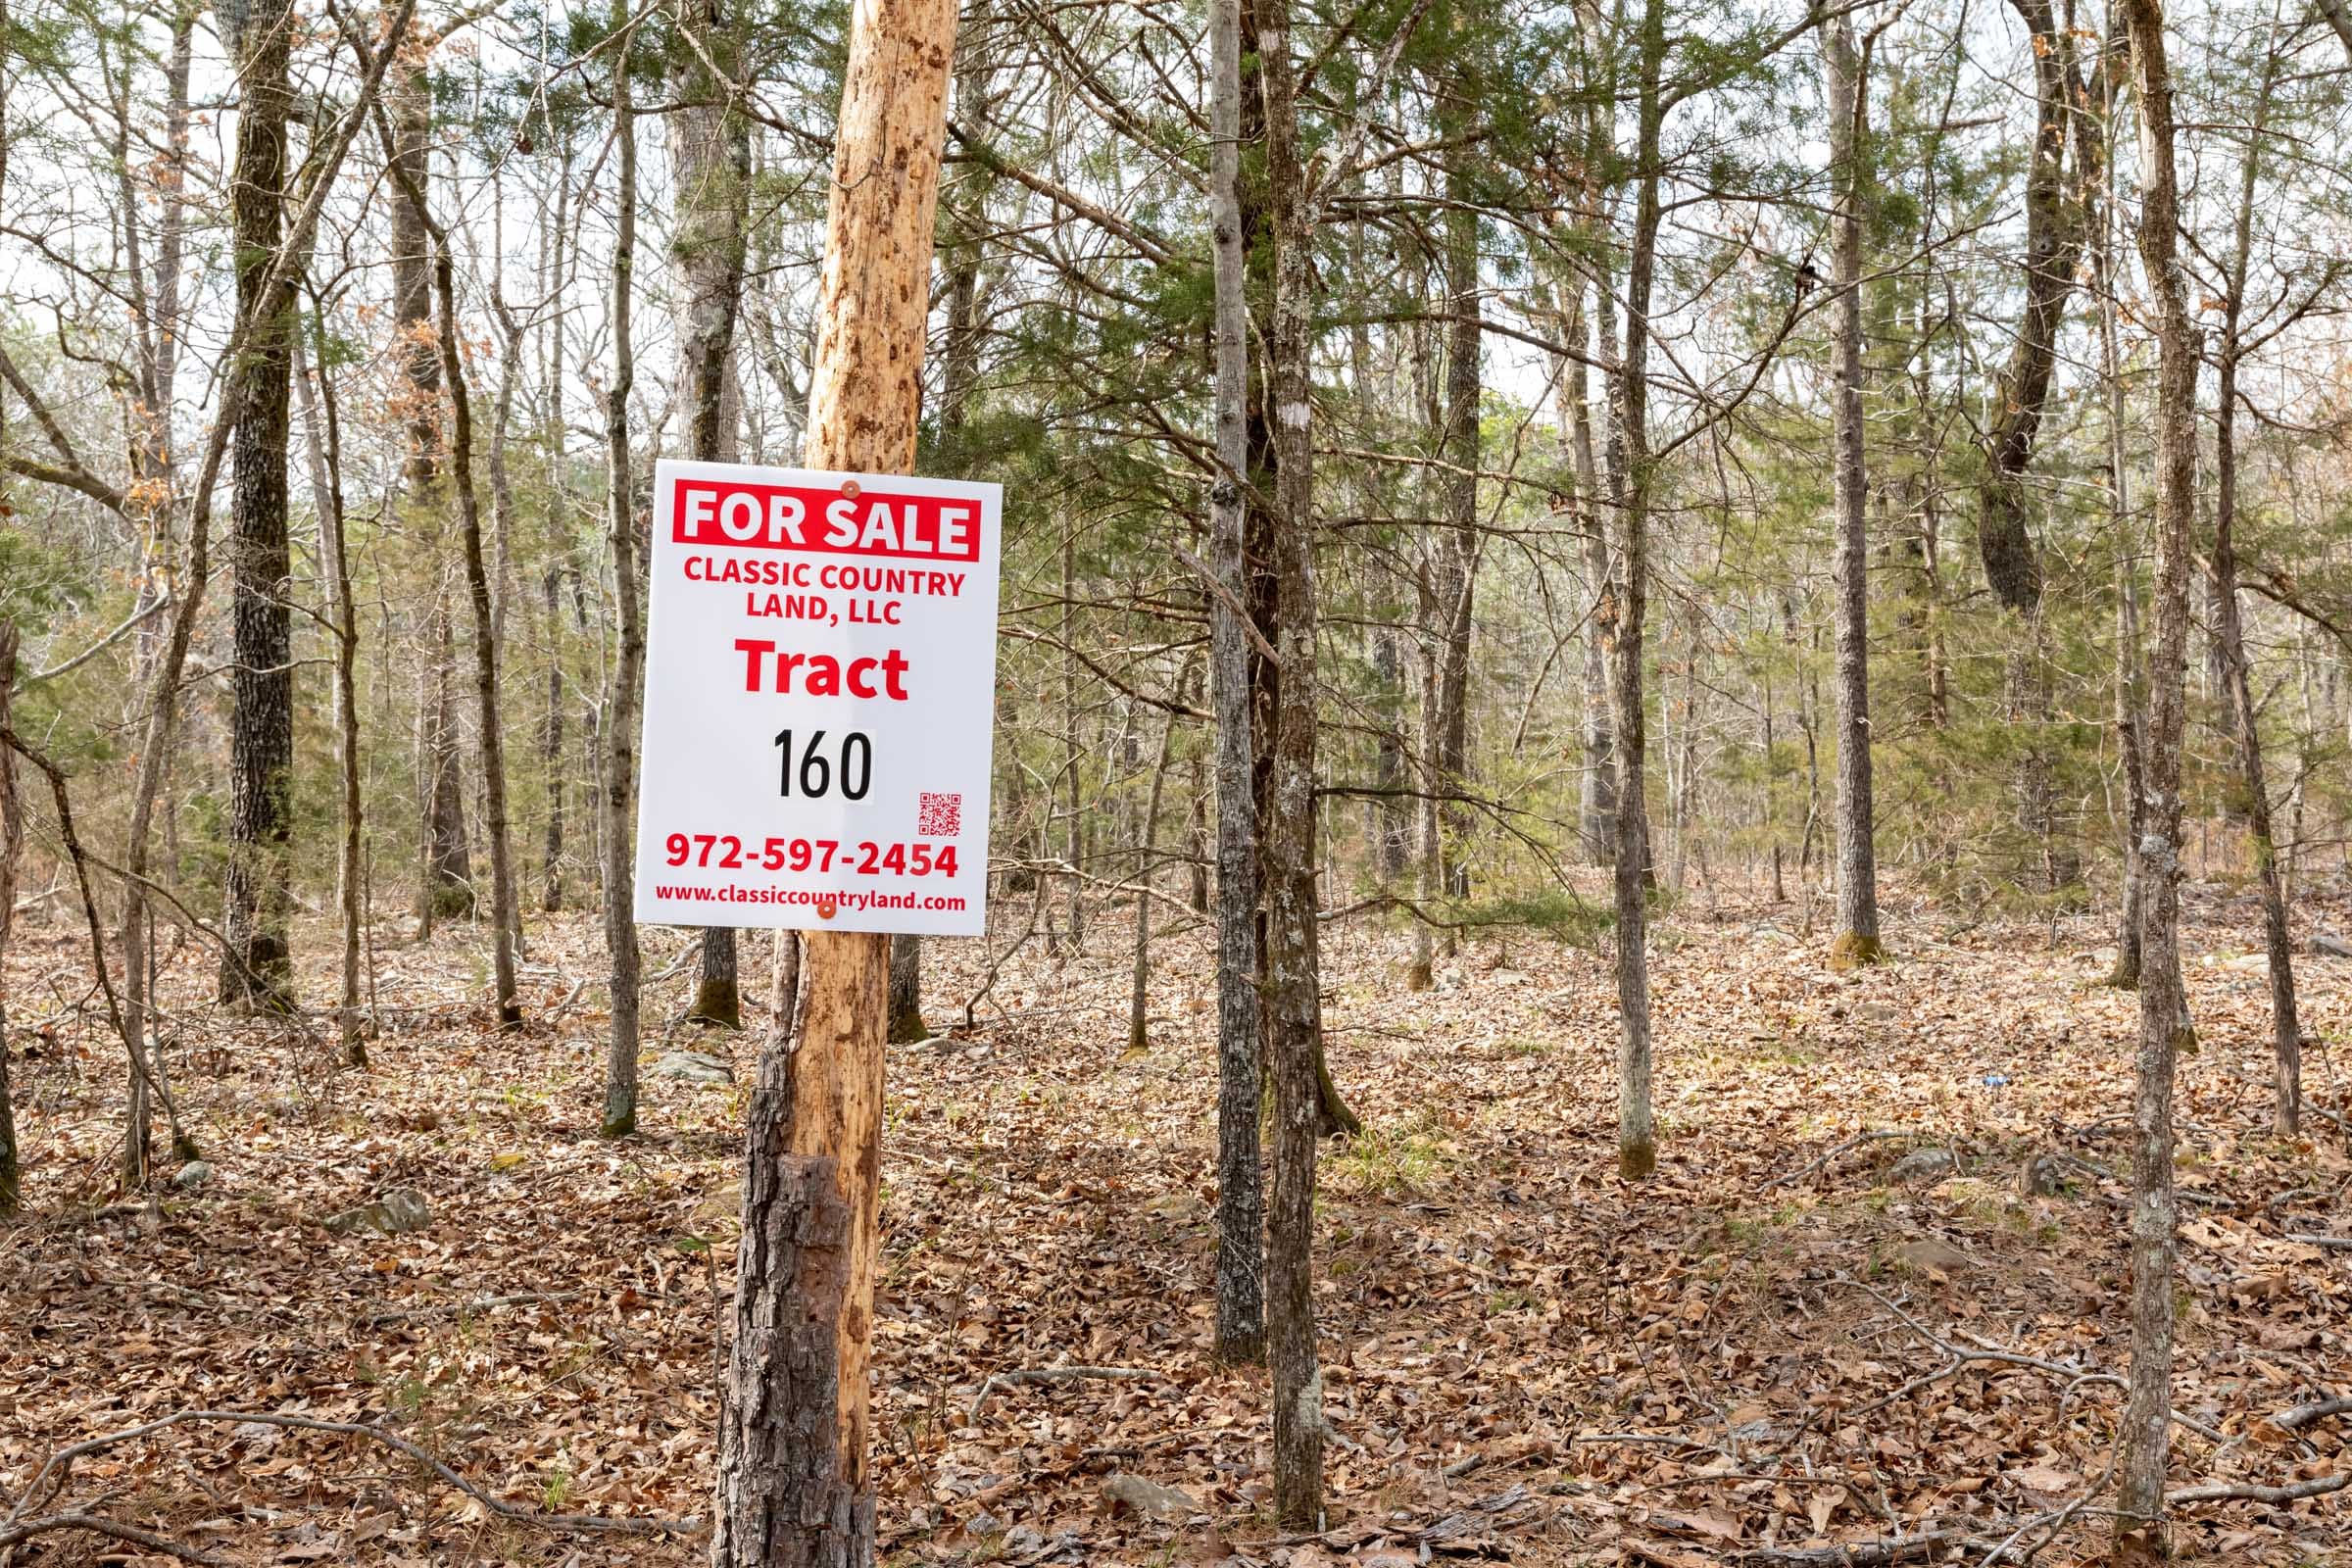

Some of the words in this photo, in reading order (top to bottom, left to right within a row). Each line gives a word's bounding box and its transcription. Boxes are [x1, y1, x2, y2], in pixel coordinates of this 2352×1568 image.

[685, 489, 807, 545] FOR
[823, 499, 970, 556] SALE
[684, 556, 810, 588] CLASSIC
[820, 564, 966, 597] COUNTRY
[746, 592, 839, 628] LAND,
[849, 599, 902, 625] LLC
[734, 638, 909, 701] Tract
[774, 729, 872, 801] 160
[665, 833, 959, 878] 972-597-2454
[655, 883, 966, 912] www.classiccountryland.com
